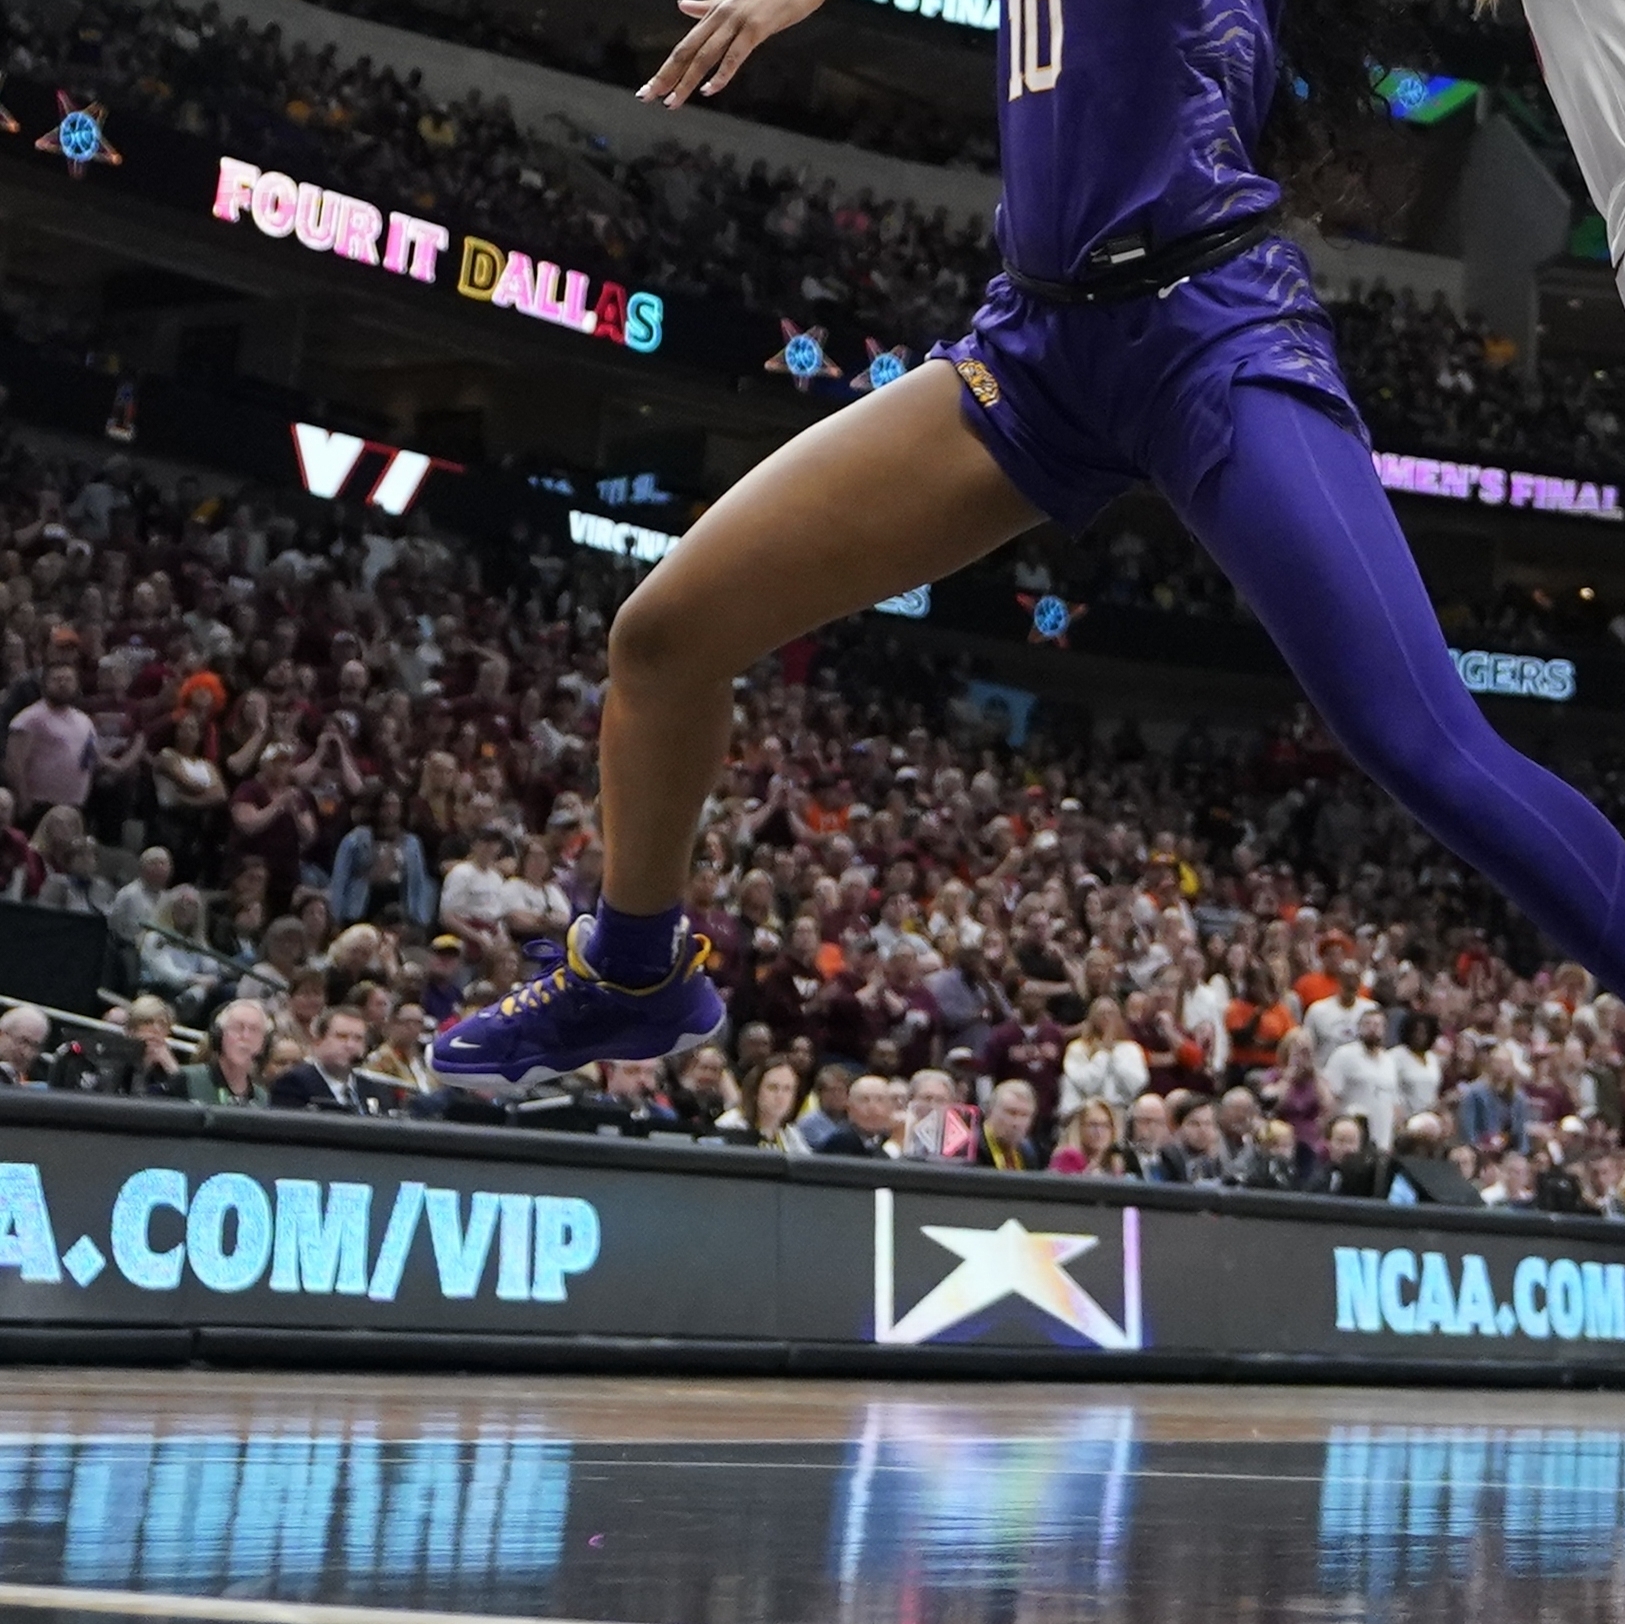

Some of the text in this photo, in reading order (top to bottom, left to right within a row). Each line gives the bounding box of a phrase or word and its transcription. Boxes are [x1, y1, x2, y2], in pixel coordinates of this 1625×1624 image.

[212, 156, 664, 354] FOUR IT DALLAS
[1509, 471, 1625, 521] FINAL
[1448, 647, 1577, 702] GERS
